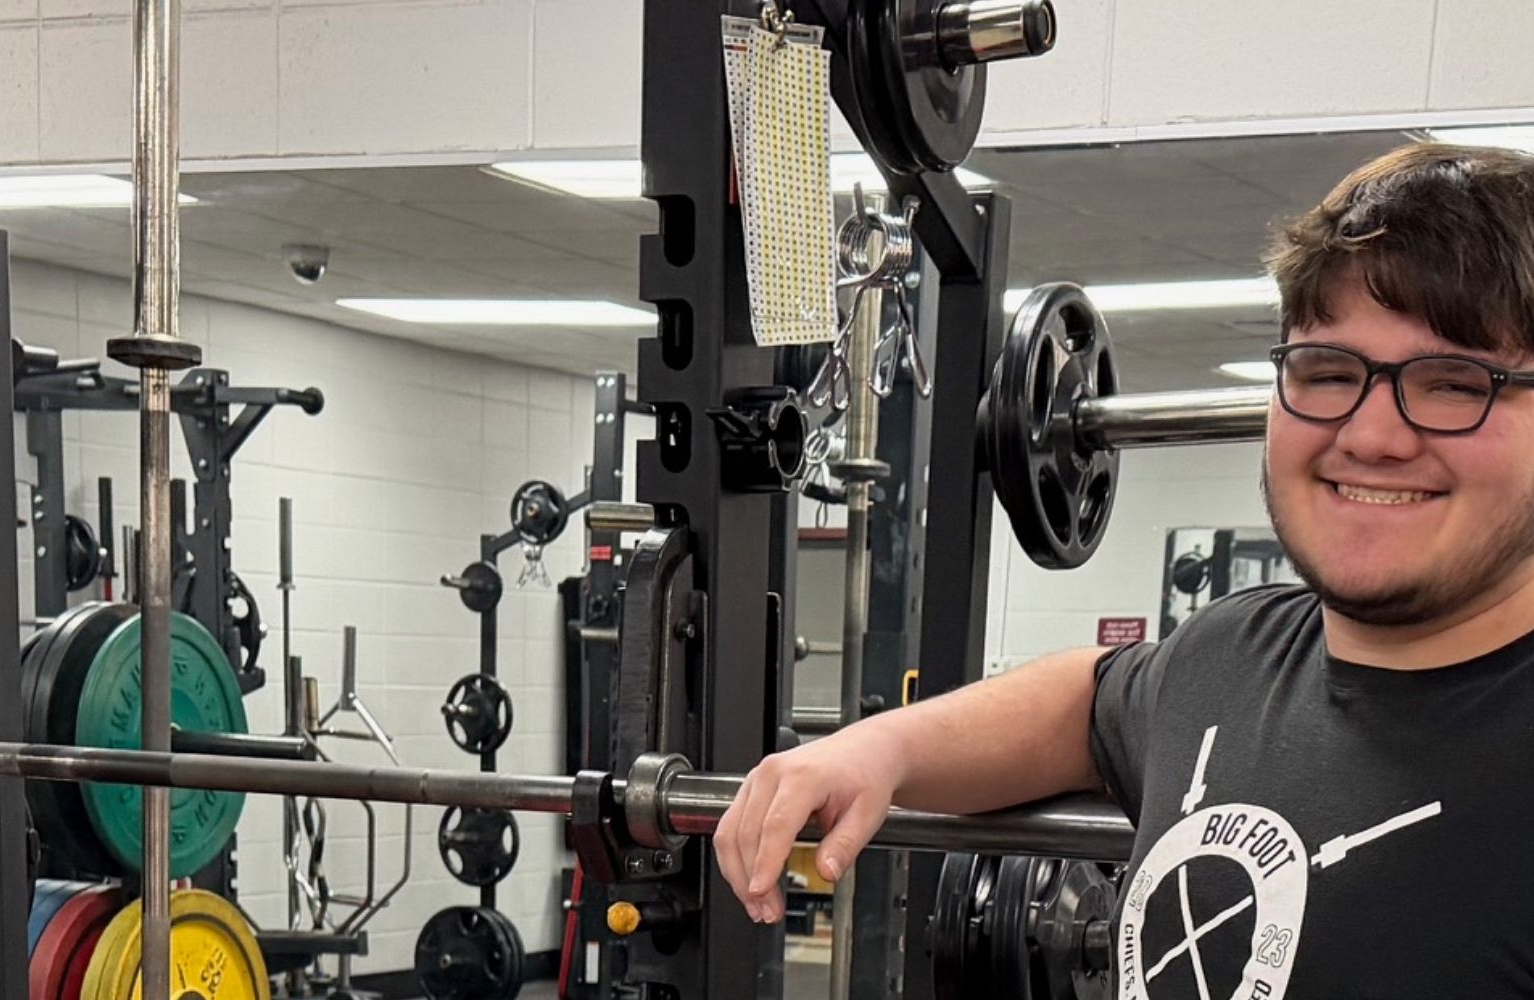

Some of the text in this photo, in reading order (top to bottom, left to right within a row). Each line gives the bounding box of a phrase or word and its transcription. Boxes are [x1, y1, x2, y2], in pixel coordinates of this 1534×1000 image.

[1201, 813, 1296, 881] BIG FOOT
[1256, 923, 1293, 969] 23
